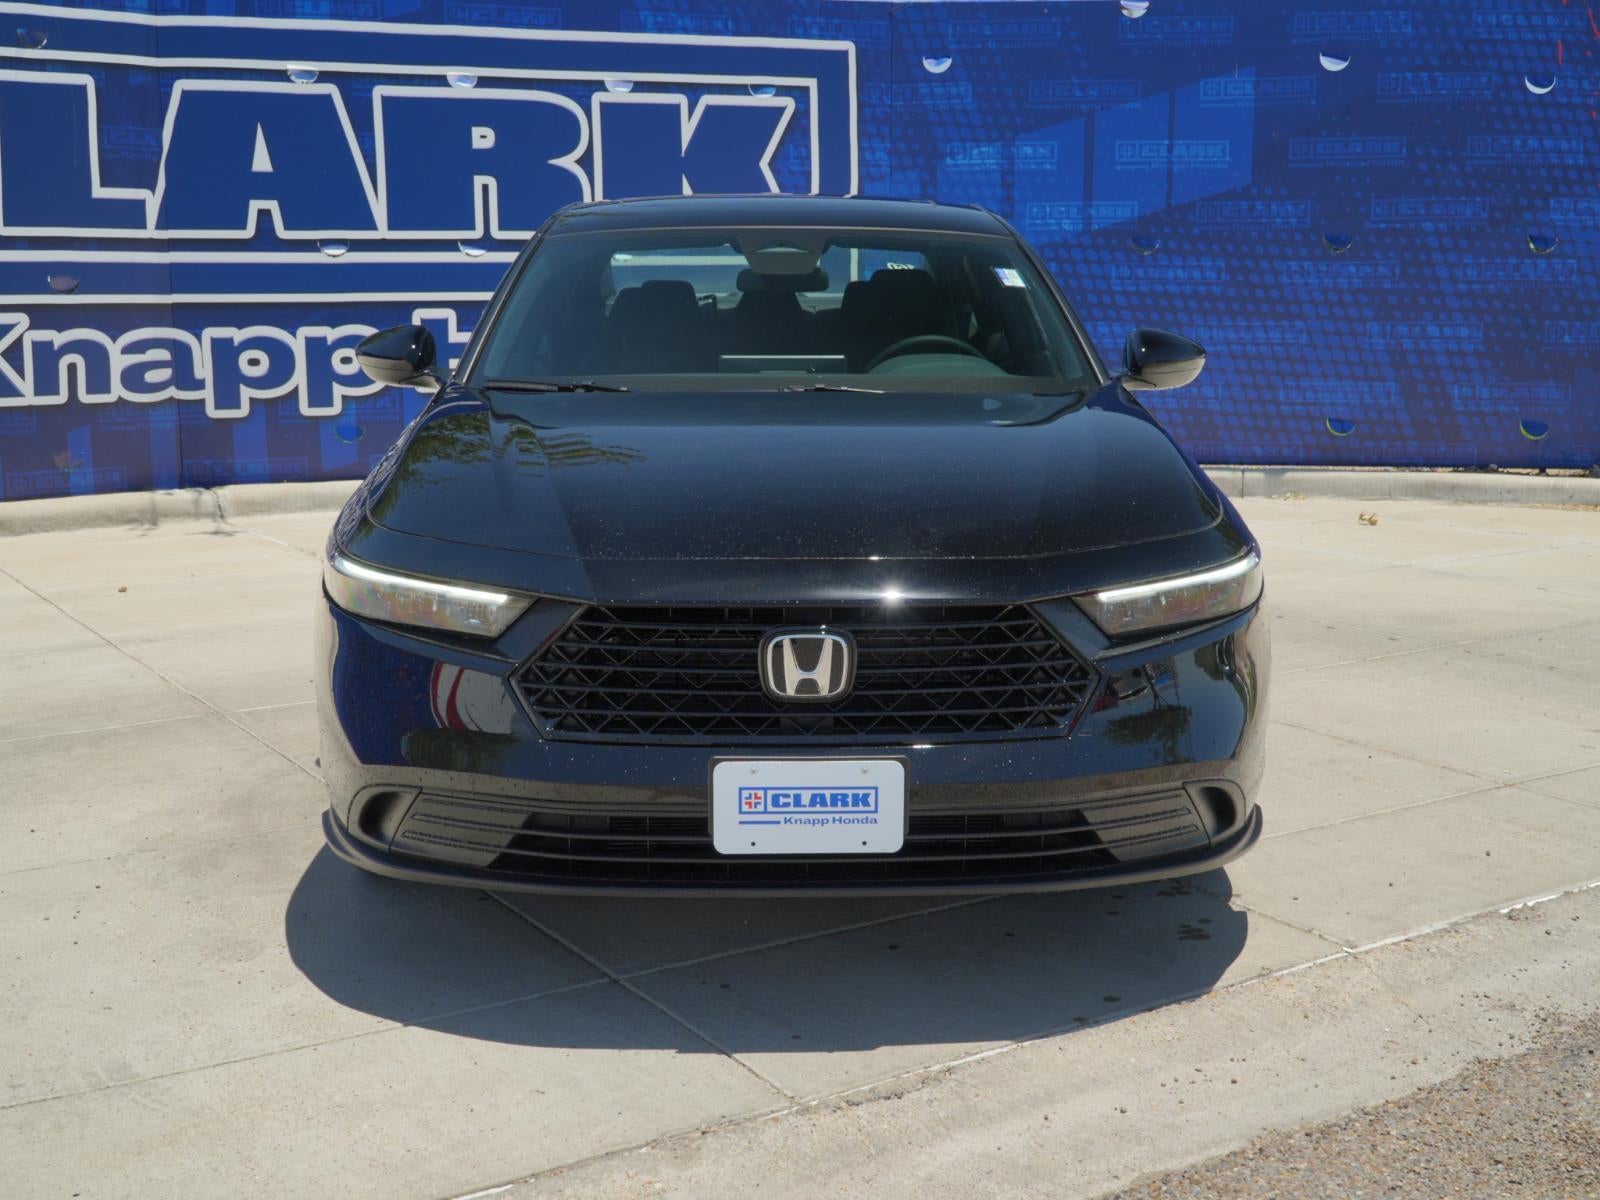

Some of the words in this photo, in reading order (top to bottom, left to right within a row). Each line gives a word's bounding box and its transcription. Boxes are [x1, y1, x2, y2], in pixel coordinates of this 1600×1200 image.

[771, 792, 872, 808] CLARK
[783, 816, 829, 826] Knapp
[832, 815, 878, 825] Honda
